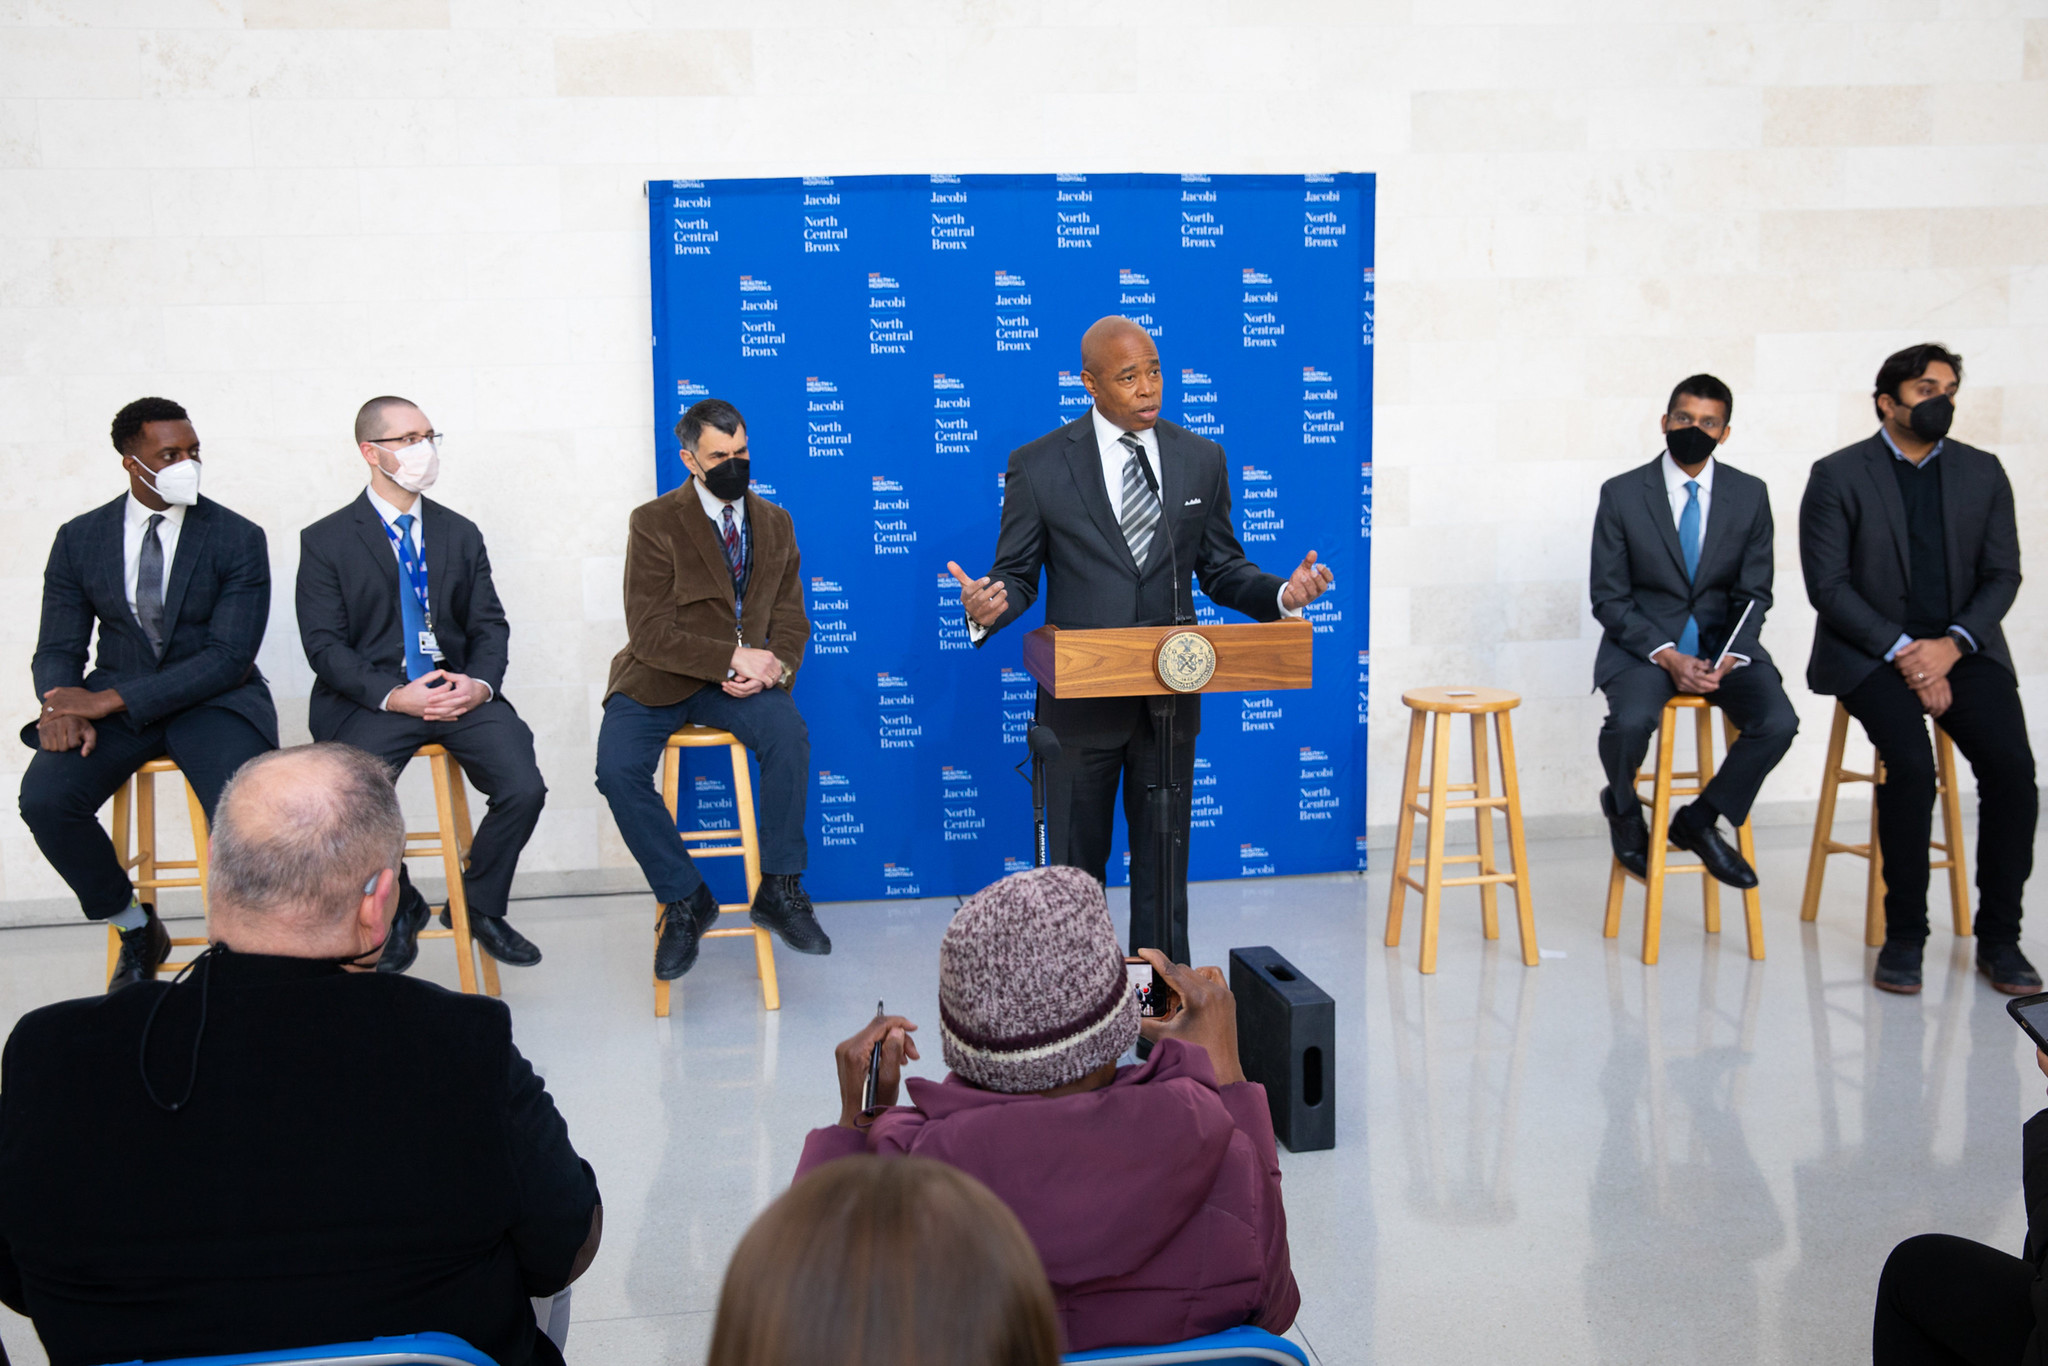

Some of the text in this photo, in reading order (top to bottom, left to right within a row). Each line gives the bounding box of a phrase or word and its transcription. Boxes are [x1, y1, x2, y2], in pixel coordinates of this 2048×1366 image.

[803, 194, 840, 205] Jacobi
[930, 192, 967, 203] Jacobi
[1057, 190, 1092, 202] Jacobi
[1181, 191, 1217, 202] Jacobi
[1304, 191, 1340, 202] Jacobi
[673, 197, 711, 208] Jacobi
[805, 216, 838, 227] North
[932, 213, 965, 224] North
[1058, 212, 1090, 223] North
[1182, 212, 1214, 223] North
[1305, 212, 1337, 223] North
[675, 218, 708, 229] North
[803, 228, 848, 239] Central
[931, 226, 974, 237] Central
[1057, 224, 1100, 235] Central
[1181, 224, 1223, 235] Central
[1304, 224, 1346, 235] Central
[674, 231, 718, 242] Central
[1182, 236, 1216, 247] Bronx
[1305, 236, 1338, 247] Bronx
[805, 241, 840, 252] Bronx
[932, 239, 967, 250] Bronx
[1058, 237, 1092, 248] Bronx
[675, 244, 711, 255] Bronx
[869, 297, 905, 308] Jacobi
[995, 294, 1031, 305] Jacobi
[1120, 293, 1155, 304] Jacobi
[1243, 292, 1278, 303] Jacobi
[741, 299, 778, 311] Jacobi
[997, 315, 1029, 326] North
[1244, 312, 1275, 323] North
[742, 321, 775, 332] North
[870, 318, 903, 329] North
[996, 327, 1038, 338] Central
[1243, 324, 1284, 335] Central
[741, 333, 785, 344] Central
[869, 330, 913, 341] Central
[997, 340, 1031, 351] Bronx
[1244, 336, 1277, 347] Bronx
[742, 346, 778, 357] Bronx
[871, 343, 905, 354] Bronx
[1182, 392, 1217, 403] Jacobi
[1303, 389, 1338, 400] Jacobi
[807, 400, 844, 411] Jacobi
[934, 397, 970, 408] Jacobi
[1184, 413, 1215, 423] North
[1304, 410, 1335, 420] North
[809, 421, 841, 432] North
[936, 418, 968, 429] North
[1303, 421, 1344, 432] Central
[808, 433, 851, 444] Central
[934, 430, 978, 441] Central
[1304, 433, 1336, 444] Bronx
[809, 446, 844, 457] Bronx
[936, 443, 970, 454] Bronx
[1243, 488, 1277, 499] Jacobi
[873, 499, 909, 510] Jacobi
[1244, 508, 1275, 518] North
[875, 520, 907, 530] North
[1242, 519, 1284, 530] Central
[874, 531, 917, 542] Central
[1243, 532, 1276, 542] Bronx
[875, 544, 909, 554] Bronx
[812, 599, 849, 610] Jacobi
[814, 620, 847, 630] North
[939, 617, 964, 626] Nort
[813, 631, 857, 642] Central
[815, 644, 849, 654] Bronx
[878, 695, 914, 705] Jacobi
[1002, 690, 1037, 700] Jacobi
[1243, 697, 1273, 708] North
[1241, 708, 1282, 720] Central
[880, 715, 912, 725] North
[879, 726, 922, 736] Central
[1242, 721, 1275, 732] Bronx
[881, 738, 914, 748] Bronx
[1300, 768, 1333, 779] Jacobi
[943, 788, 977, 798] Jacobi
[1301, 787, 1330, 797] North
[698, 798, 732, 808] Jacobi
[820, 793, 856, 803] Jacobi
[1191, 795, 1214, 805] orth
[1299, 797, 1339, 809] Central
[945, 807, 975, 817] North
[1190, 805, 1223, 817] entral
[1300, 811, 1332, 820] Bronx
[822, 812, 854, 822] North
[698, 818, 731, 828] North
[822, 823, 864, 834] Central
[943, 818, 985, 828] Central
[823, 836, 856, 846] Bronx
[945, 831, 977, 840] Bronx
[1241, 864, 1275, 875] Jacobi
[885, 885, 920, 895] Jacobi
